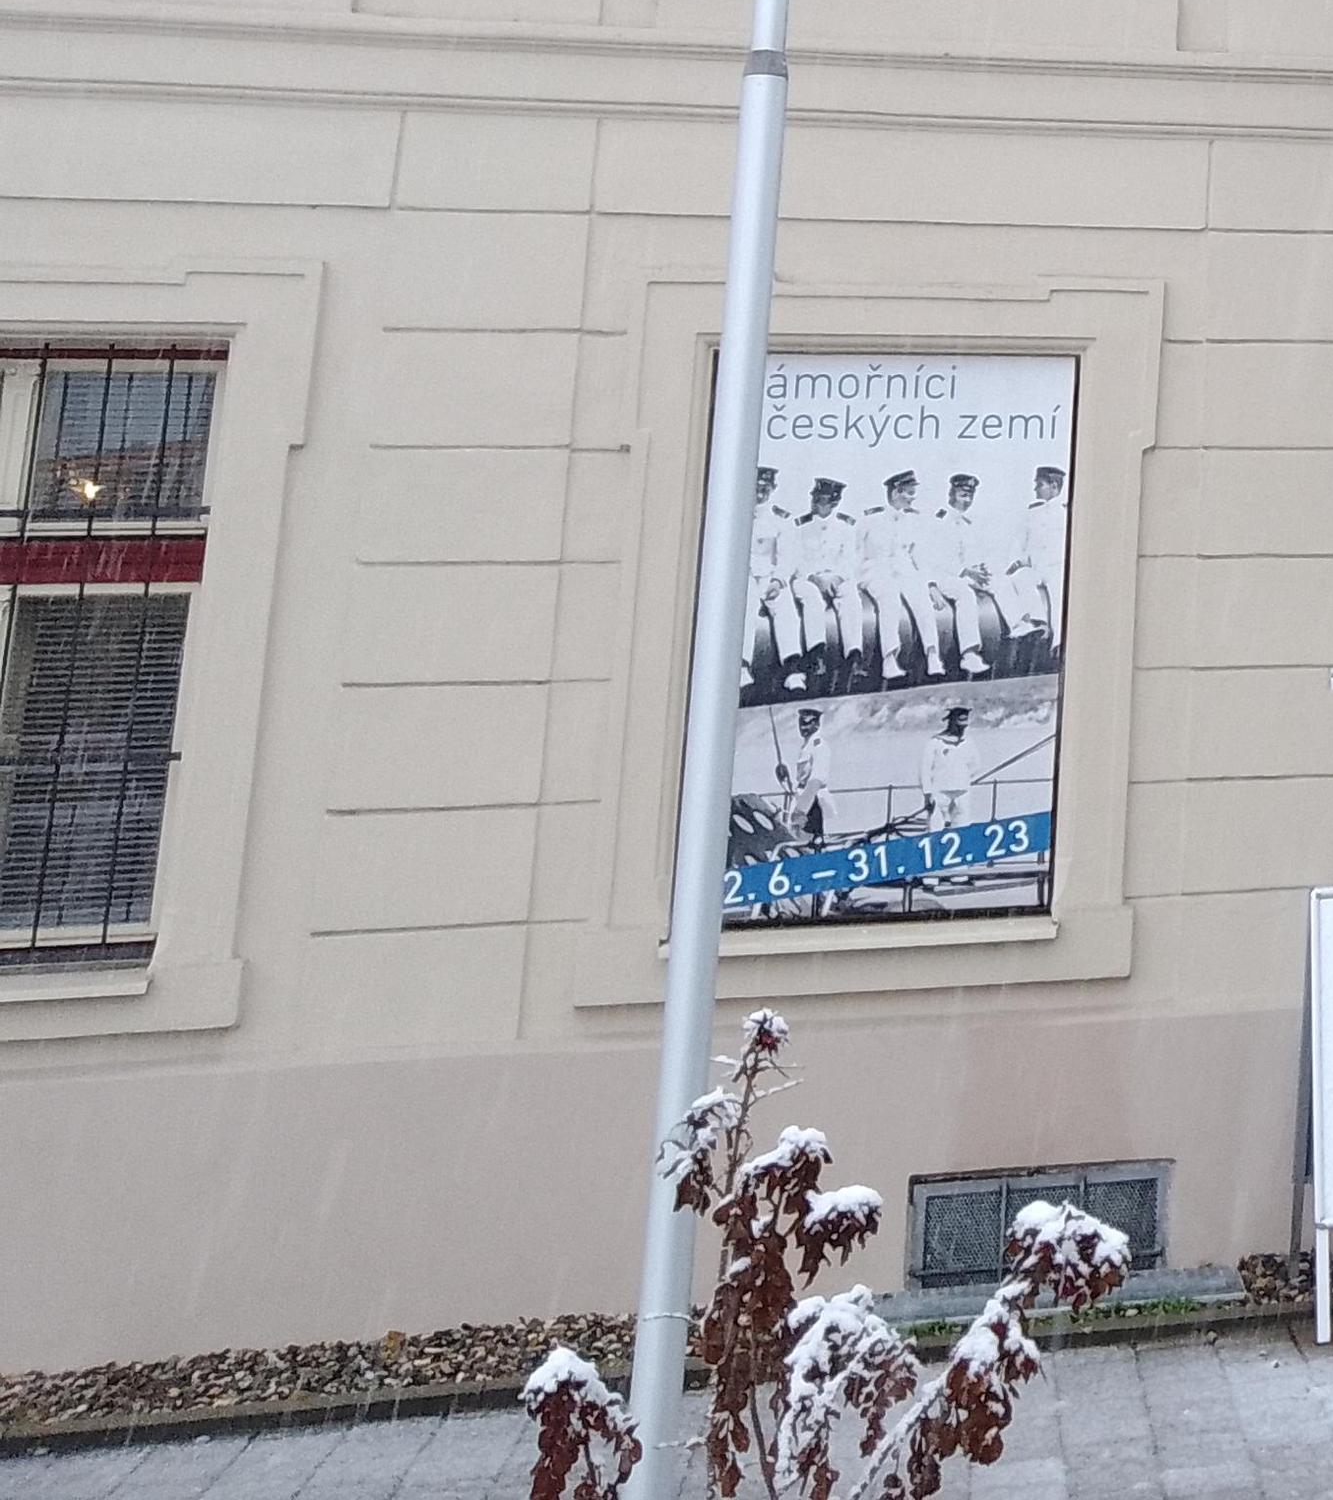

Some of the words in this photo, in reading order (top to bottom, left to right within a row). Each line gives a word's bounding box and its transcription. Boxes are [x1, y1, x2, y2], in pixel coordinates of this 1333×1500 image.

[765, 363, 958, 400] ámořníci
[765, 404, 941, 448] českých
[956, 404, 1062, 441] zemí
[723, 870, 756, 905] 2.
[985, 819, 1030, 857] 23
